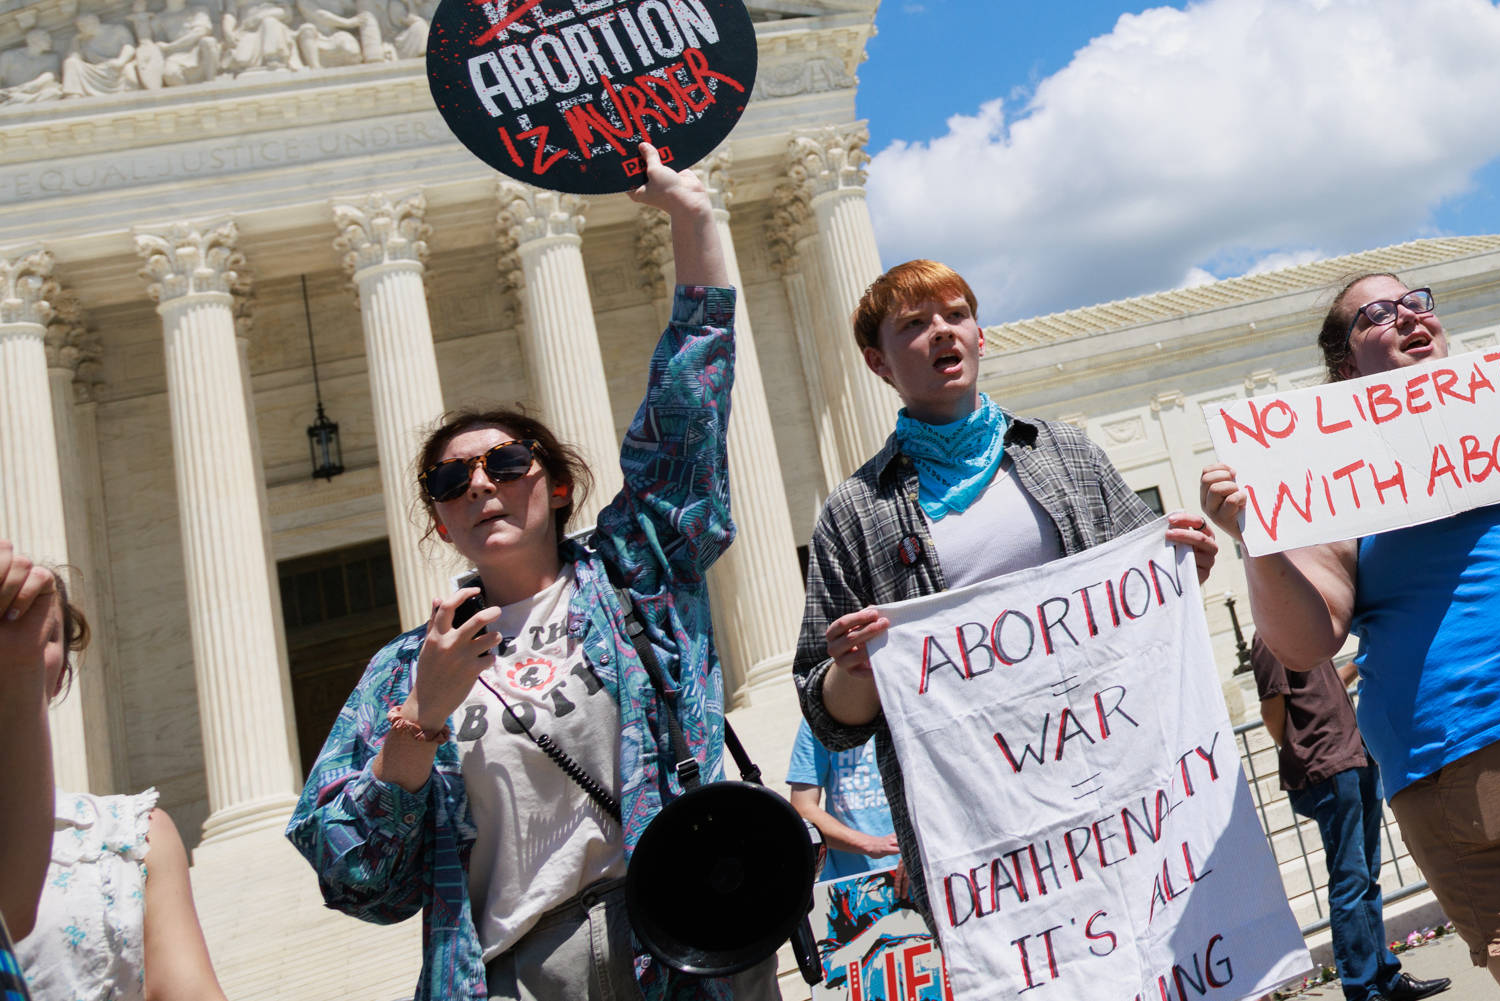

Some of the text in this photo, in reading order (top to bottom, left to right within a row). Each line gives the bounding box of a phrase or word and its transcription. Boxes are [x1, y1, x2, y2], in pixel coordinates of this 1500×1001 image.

[564, 47, 746, 160] MURDER
[14, 121, 435, 197] EQUAL JUSTICE UNDER
[1219, 400, 1298, 449] NO
[1245, 459, 1409, 542] WITH
[918, 558, 1184, 695] ABORTION
[993, 685, 1139, 774] WAR
[1010, 841, 1213, 995] IT'S ALL
[849, 942, 955, 1001] IF
